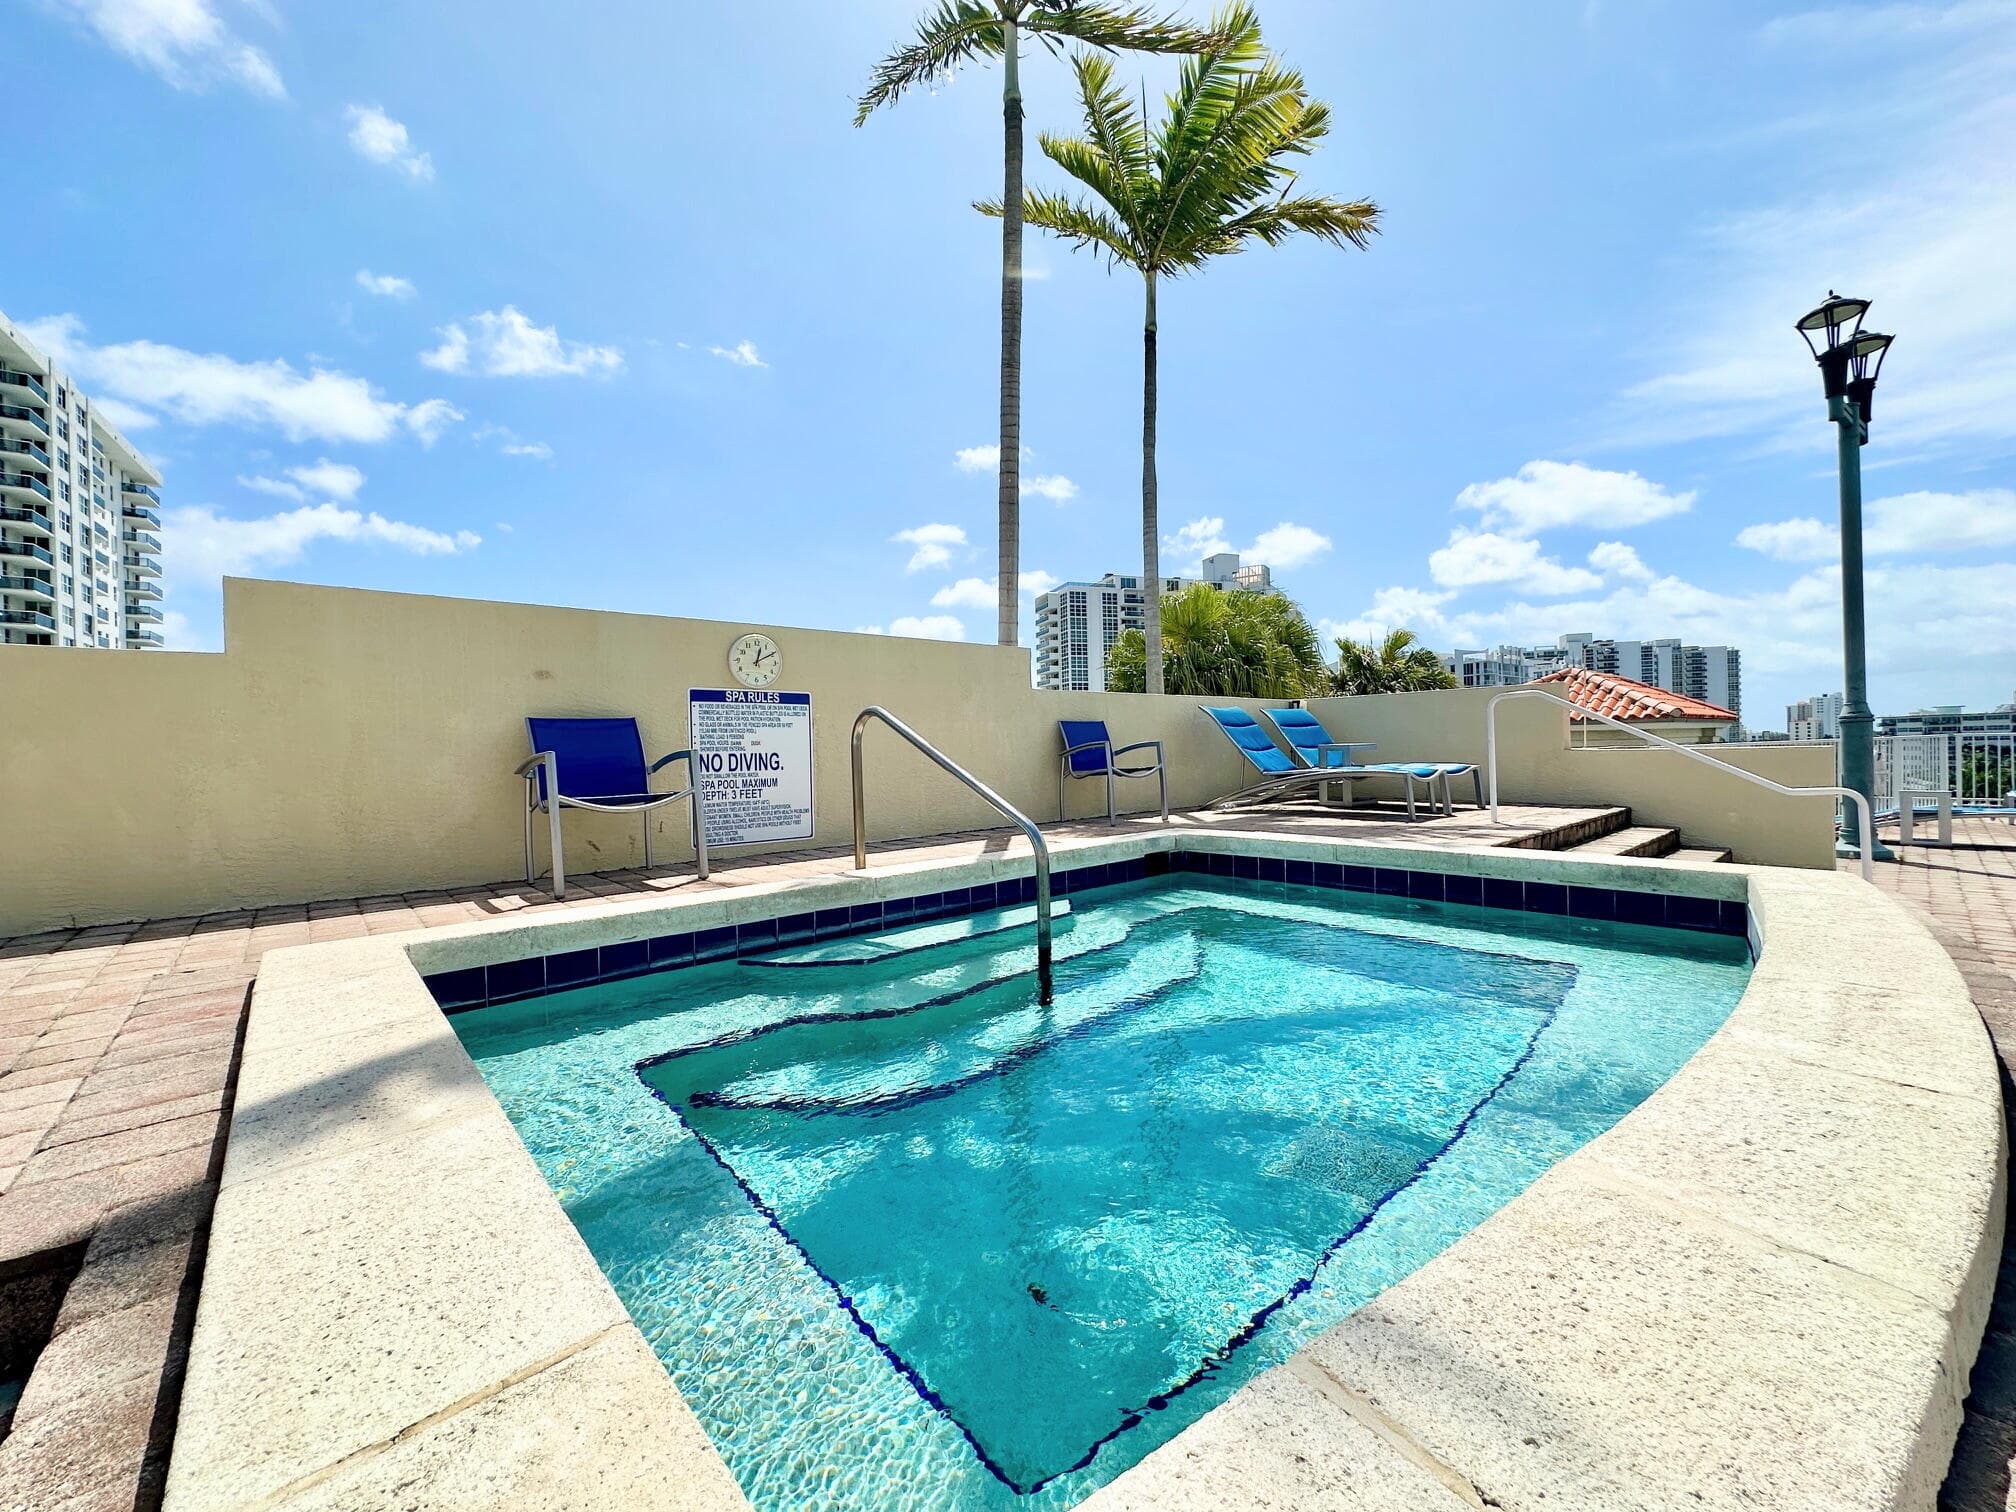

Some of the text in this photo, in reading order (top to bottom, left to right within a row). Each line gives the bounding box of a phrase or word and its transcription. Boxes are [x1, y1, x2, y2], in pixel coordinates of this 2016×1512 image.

[726, 691, 780, 702] SPA RULES
[700, 752, 784, 773] NO DIVING.
[701, 778, 778, 790] SPA POOL MAXIMUM
[732, 790, 736, 799] 3
[740, 789, 763, 799] FEET
